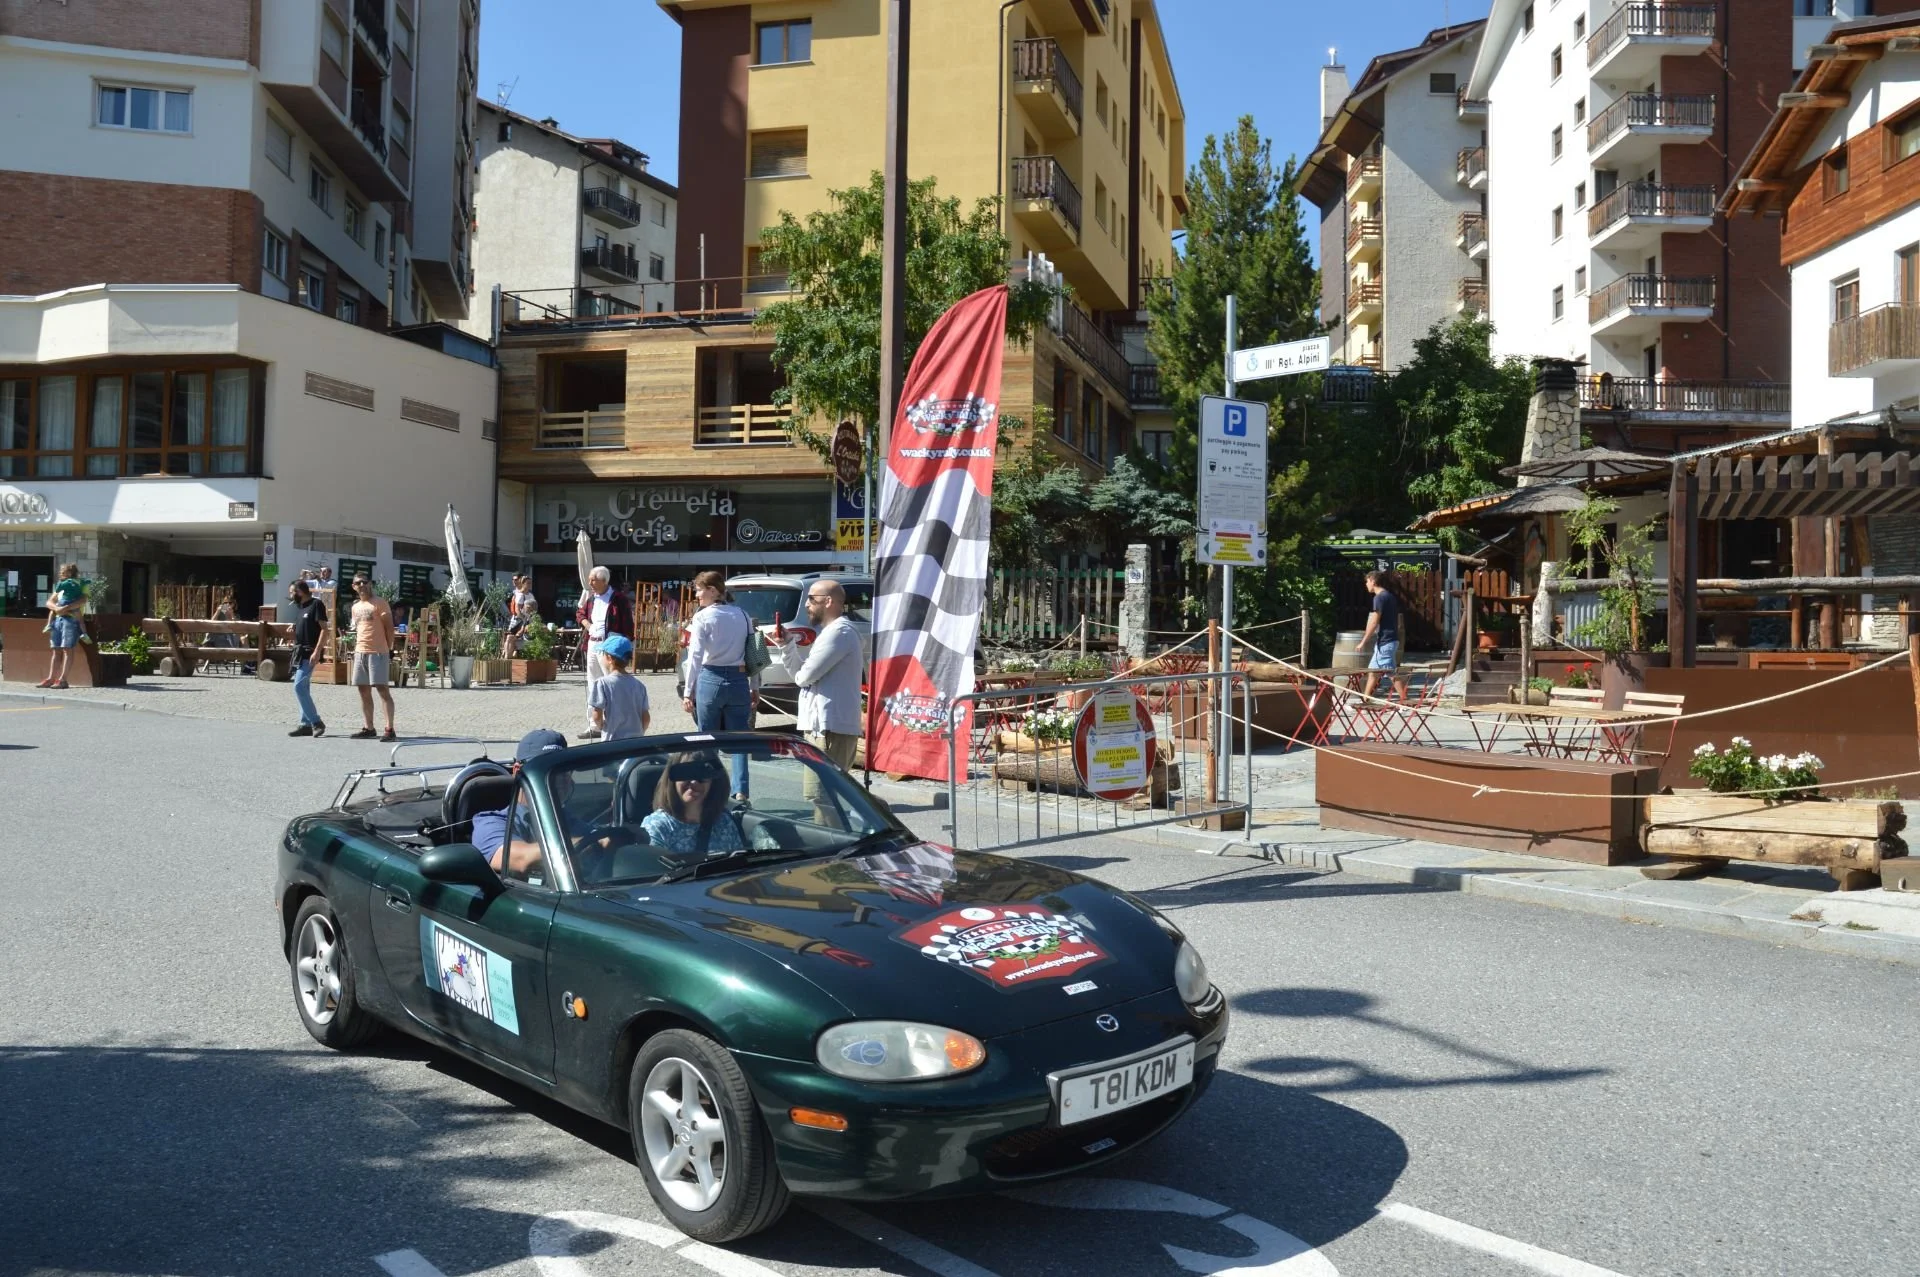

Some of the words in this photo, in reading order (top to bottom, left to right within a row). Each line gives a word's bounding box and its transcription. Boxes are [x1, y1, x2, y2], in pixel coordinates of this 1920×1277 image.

[1278, 357, 1294, 368] Rgt.
[1298, 352, 1320, 365] Alpini
[1302, 343, 1320, 352] piazza
[1228, 409, 1242, 432] P
[0, 493, 46, 515] OLO
[609, 485, 736, 520] Cremeria
[540, 499, 679, 546] Pasticceria
[896, 705, 923, 717] Wacky
[965, 931, 1015, 954] Wacky
[1011, 922, 1058, 939] Rally
[1004, 950, 1098, 981] www.wackyrally.co.uk
[1090, 1070, 1129, 1109] T81
[1135, 1053, 1178, 1097] KDM
